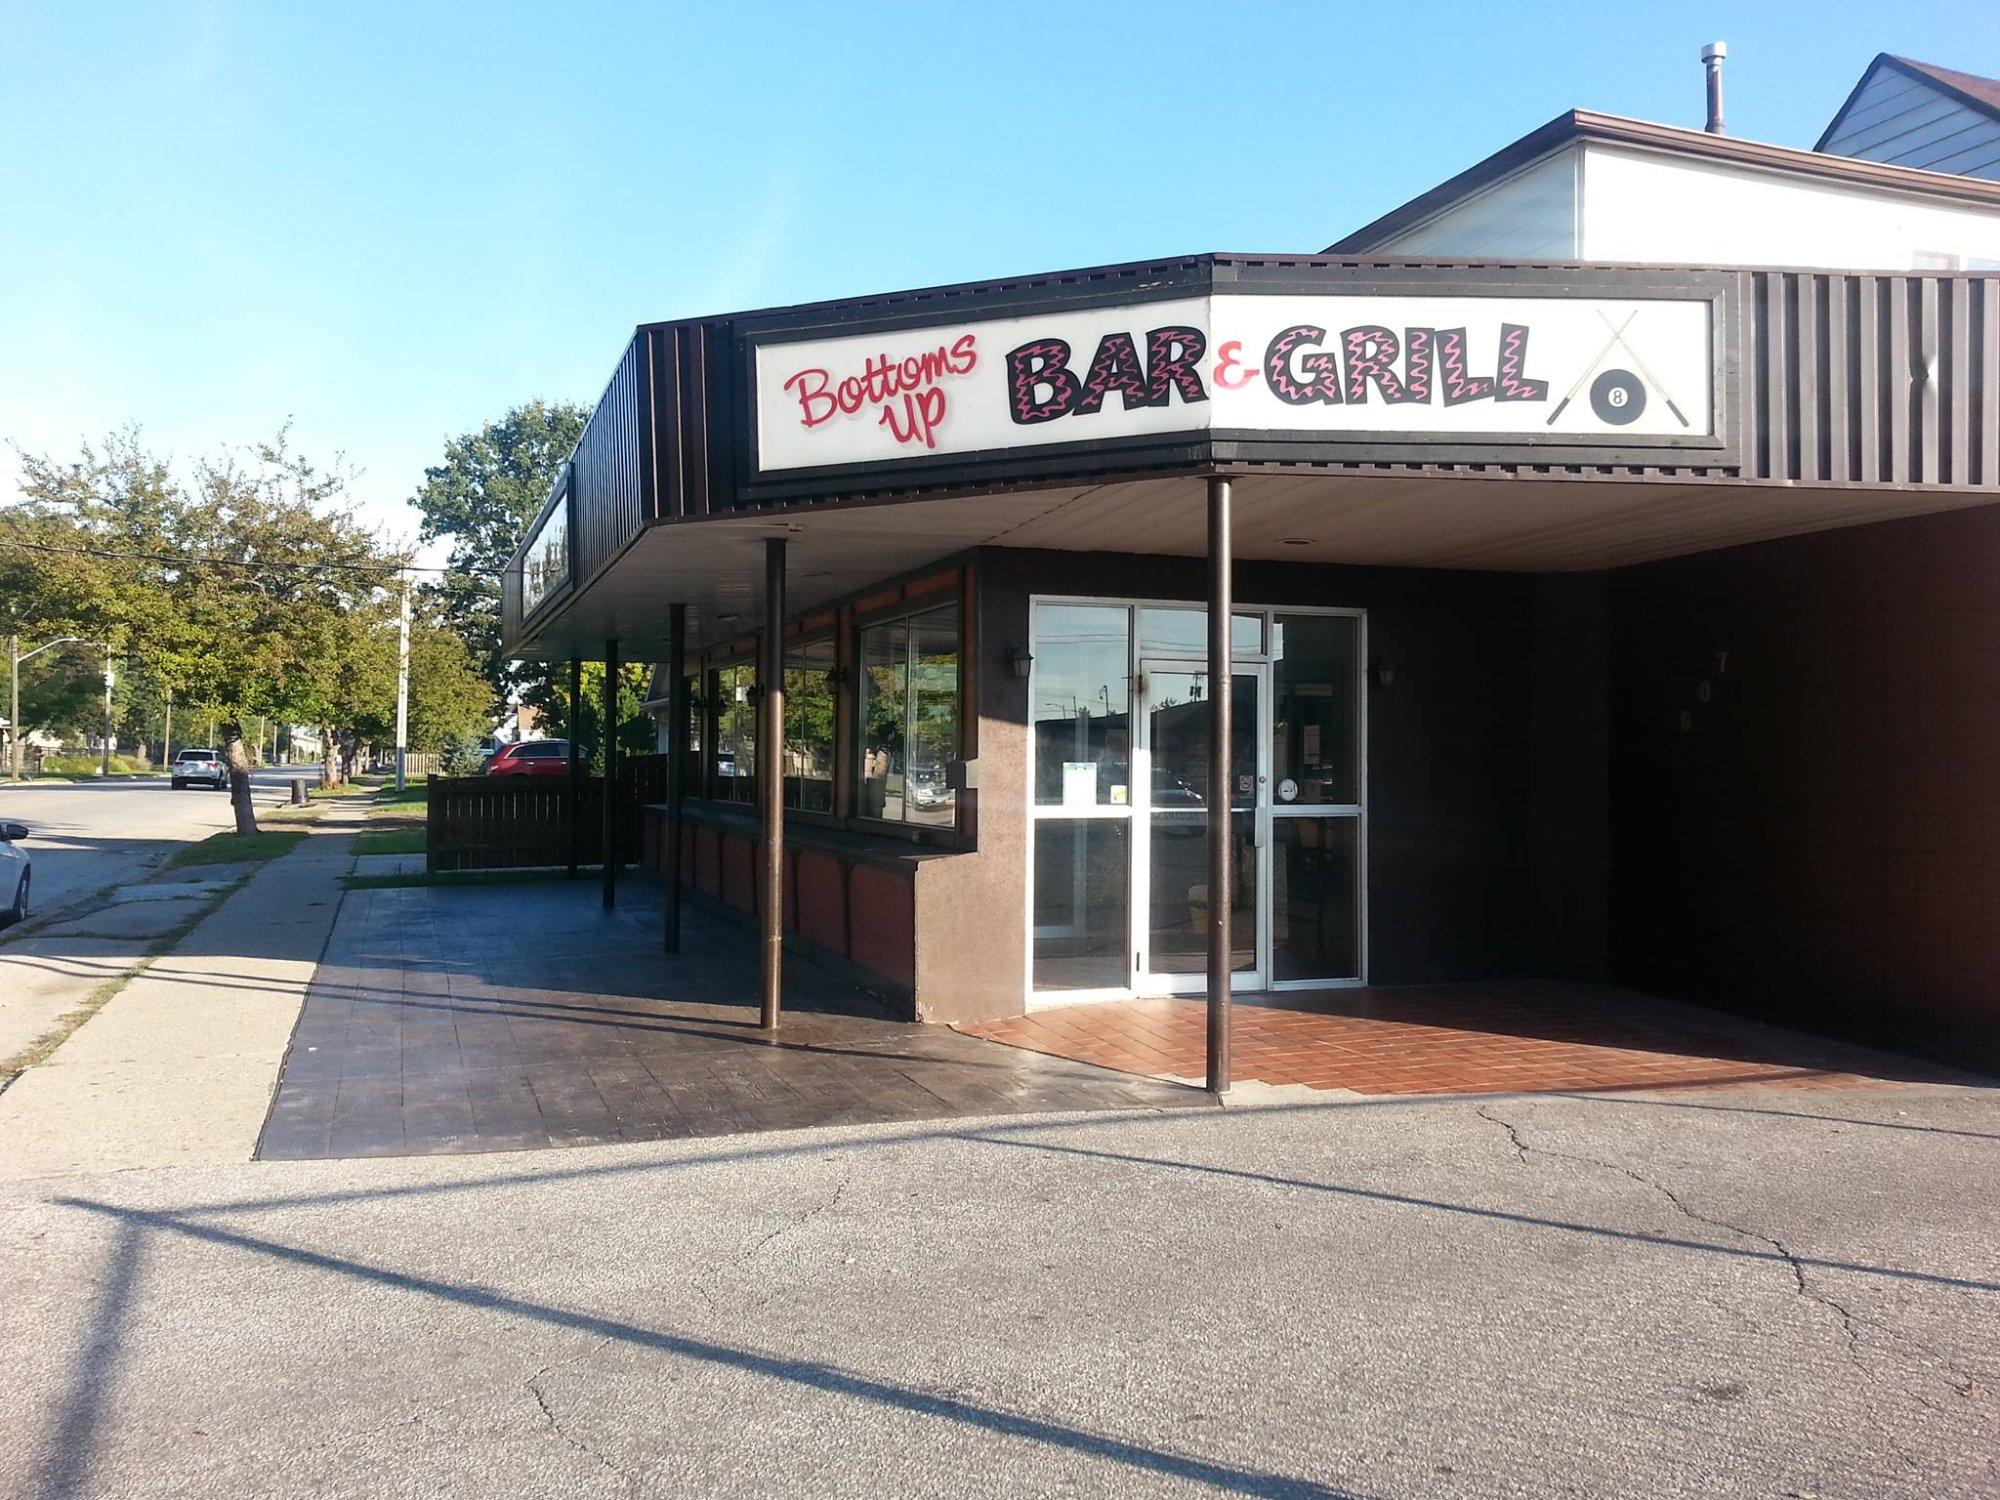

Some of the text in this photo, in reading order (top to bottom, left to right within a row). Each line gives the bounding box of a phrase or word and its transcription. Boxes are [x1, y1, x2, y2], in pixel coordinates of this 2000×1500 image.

[784, 334, 977, 428] Bottoms
[1006, 323, 1549, 425] BAR & GRILL
[1613, 390, 1623, 405] 8
